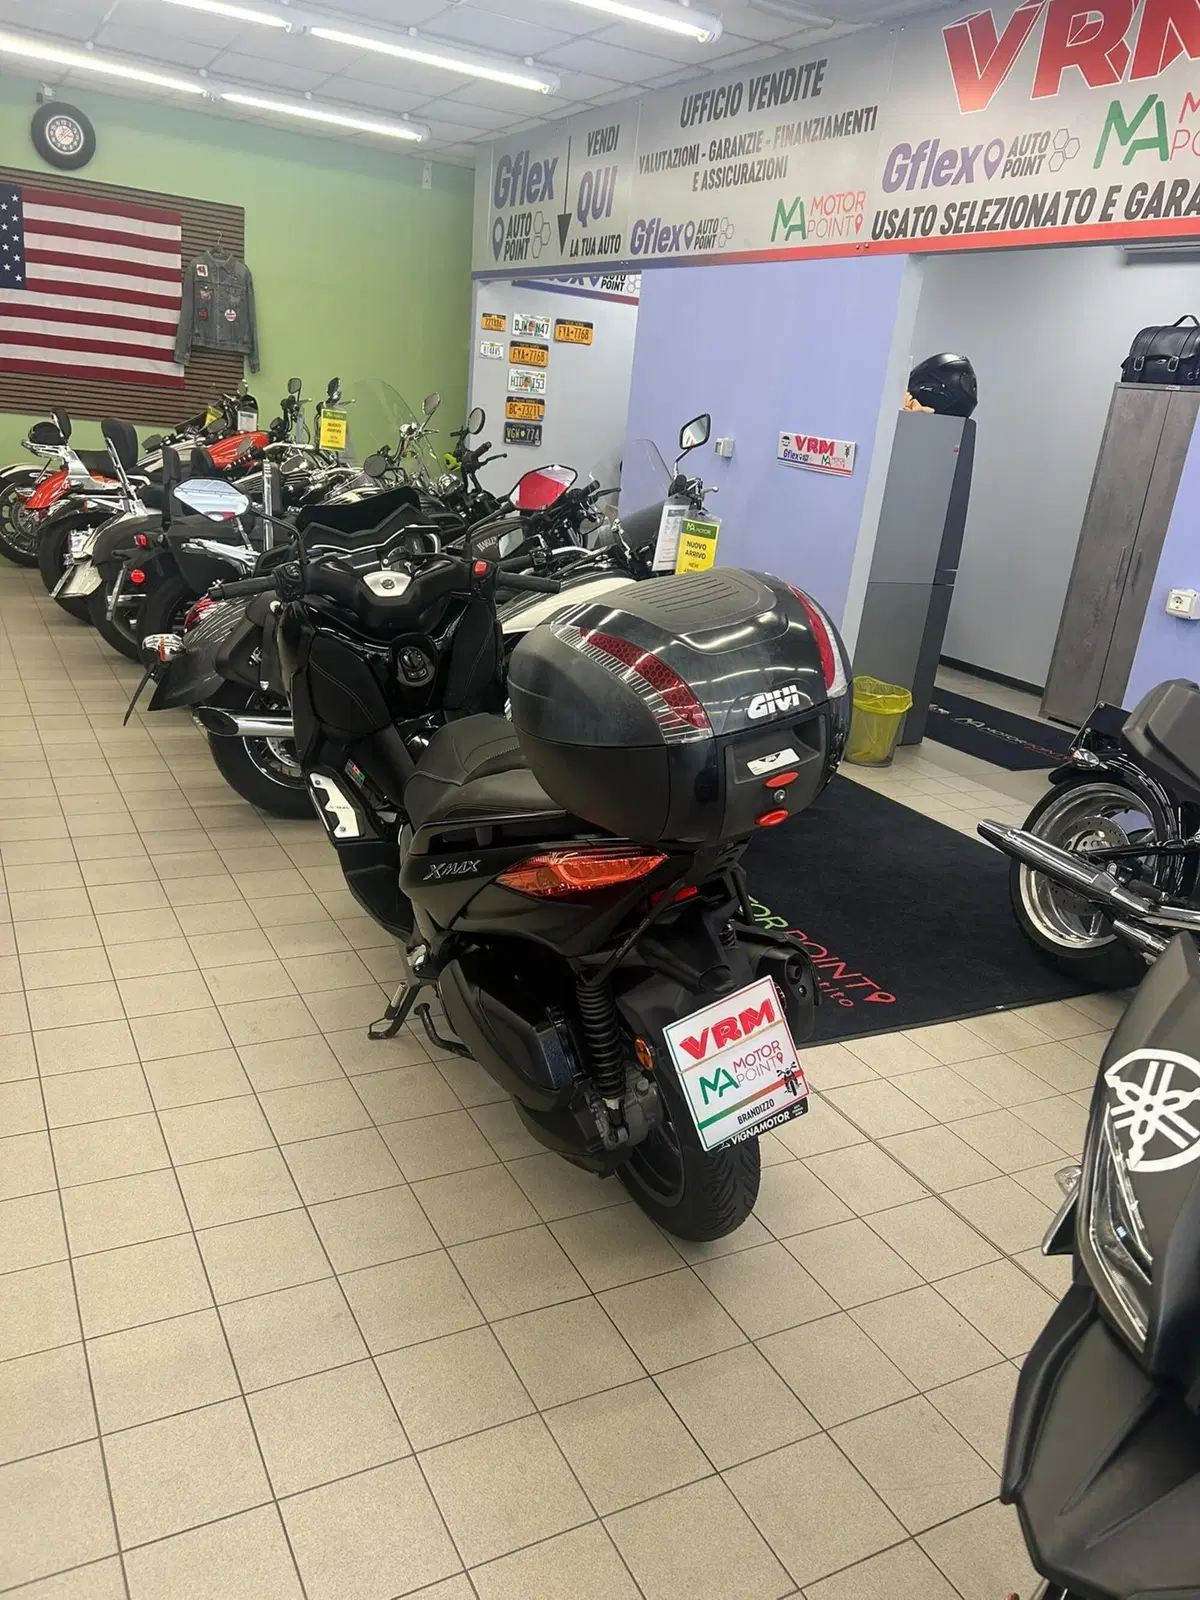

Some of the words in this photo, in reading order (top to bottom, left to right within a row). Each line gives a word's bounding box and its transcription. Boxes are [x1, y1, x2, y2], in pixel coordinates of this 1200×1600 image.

[679, 82, 744, 129] UFFICIO
[747, 58, 828, 112] VENDITE
[587, 124, 620, 157] VENDI
[638, 143, 701, 175] VALUTAZIONI
[708, 128, 764, 163] GARANZIE
[772, 105, 879, 150] FINANZIAMENTI
[1007, 130, 1051, 158] AUTO
[493, 149, 559, 210] Gflex
[692, 171, 700, 192] E
[700, 155, 789, 191] ASSICURAZIONI
[882, 138, 983, 193] Gflex
[1001, 154, 1046, 179] POINT
[577, 164, 619, 228] QUI
[810, 190, 867, 216] MOTOR
[506, 212, 533, 239] AUTO
[697, 217, 720, 236] AUTO
[807, 215, 854, 239] POINT
[871, 203, 936, 241] USATO
[939, 187, 1098, 236] SELEZIONATO
[1098, 185, 1123, 222] E
[503, 237, 531, 262] POINT
[570, 239, 579, 258] LA
[581, 236, 596, 257] TUA
[597, 233, 622, 255] AUTO
[630, 218, 683, 256] Gflex
[693, 234, 718, 251] POINT
[600, 280, 625, 292] POINT
[783, 448, 799, 461] Gflex
[795, 435, 835, 456] VRM
[685, 549, 707, 560] ARRIVO
[686, 540, 707, 551] NUOVO
[747, 684, 800, 720] GIVI
[679, 998, 776, 1061] VRM
[732, 1040, 782, 1073] MOTOR
[736, 1056, 777, 1087] POINT
[737, 1098, 775, 1125] BRANDIZZO
[731, 1110, 791, 1145] VIGNAMOTOR
